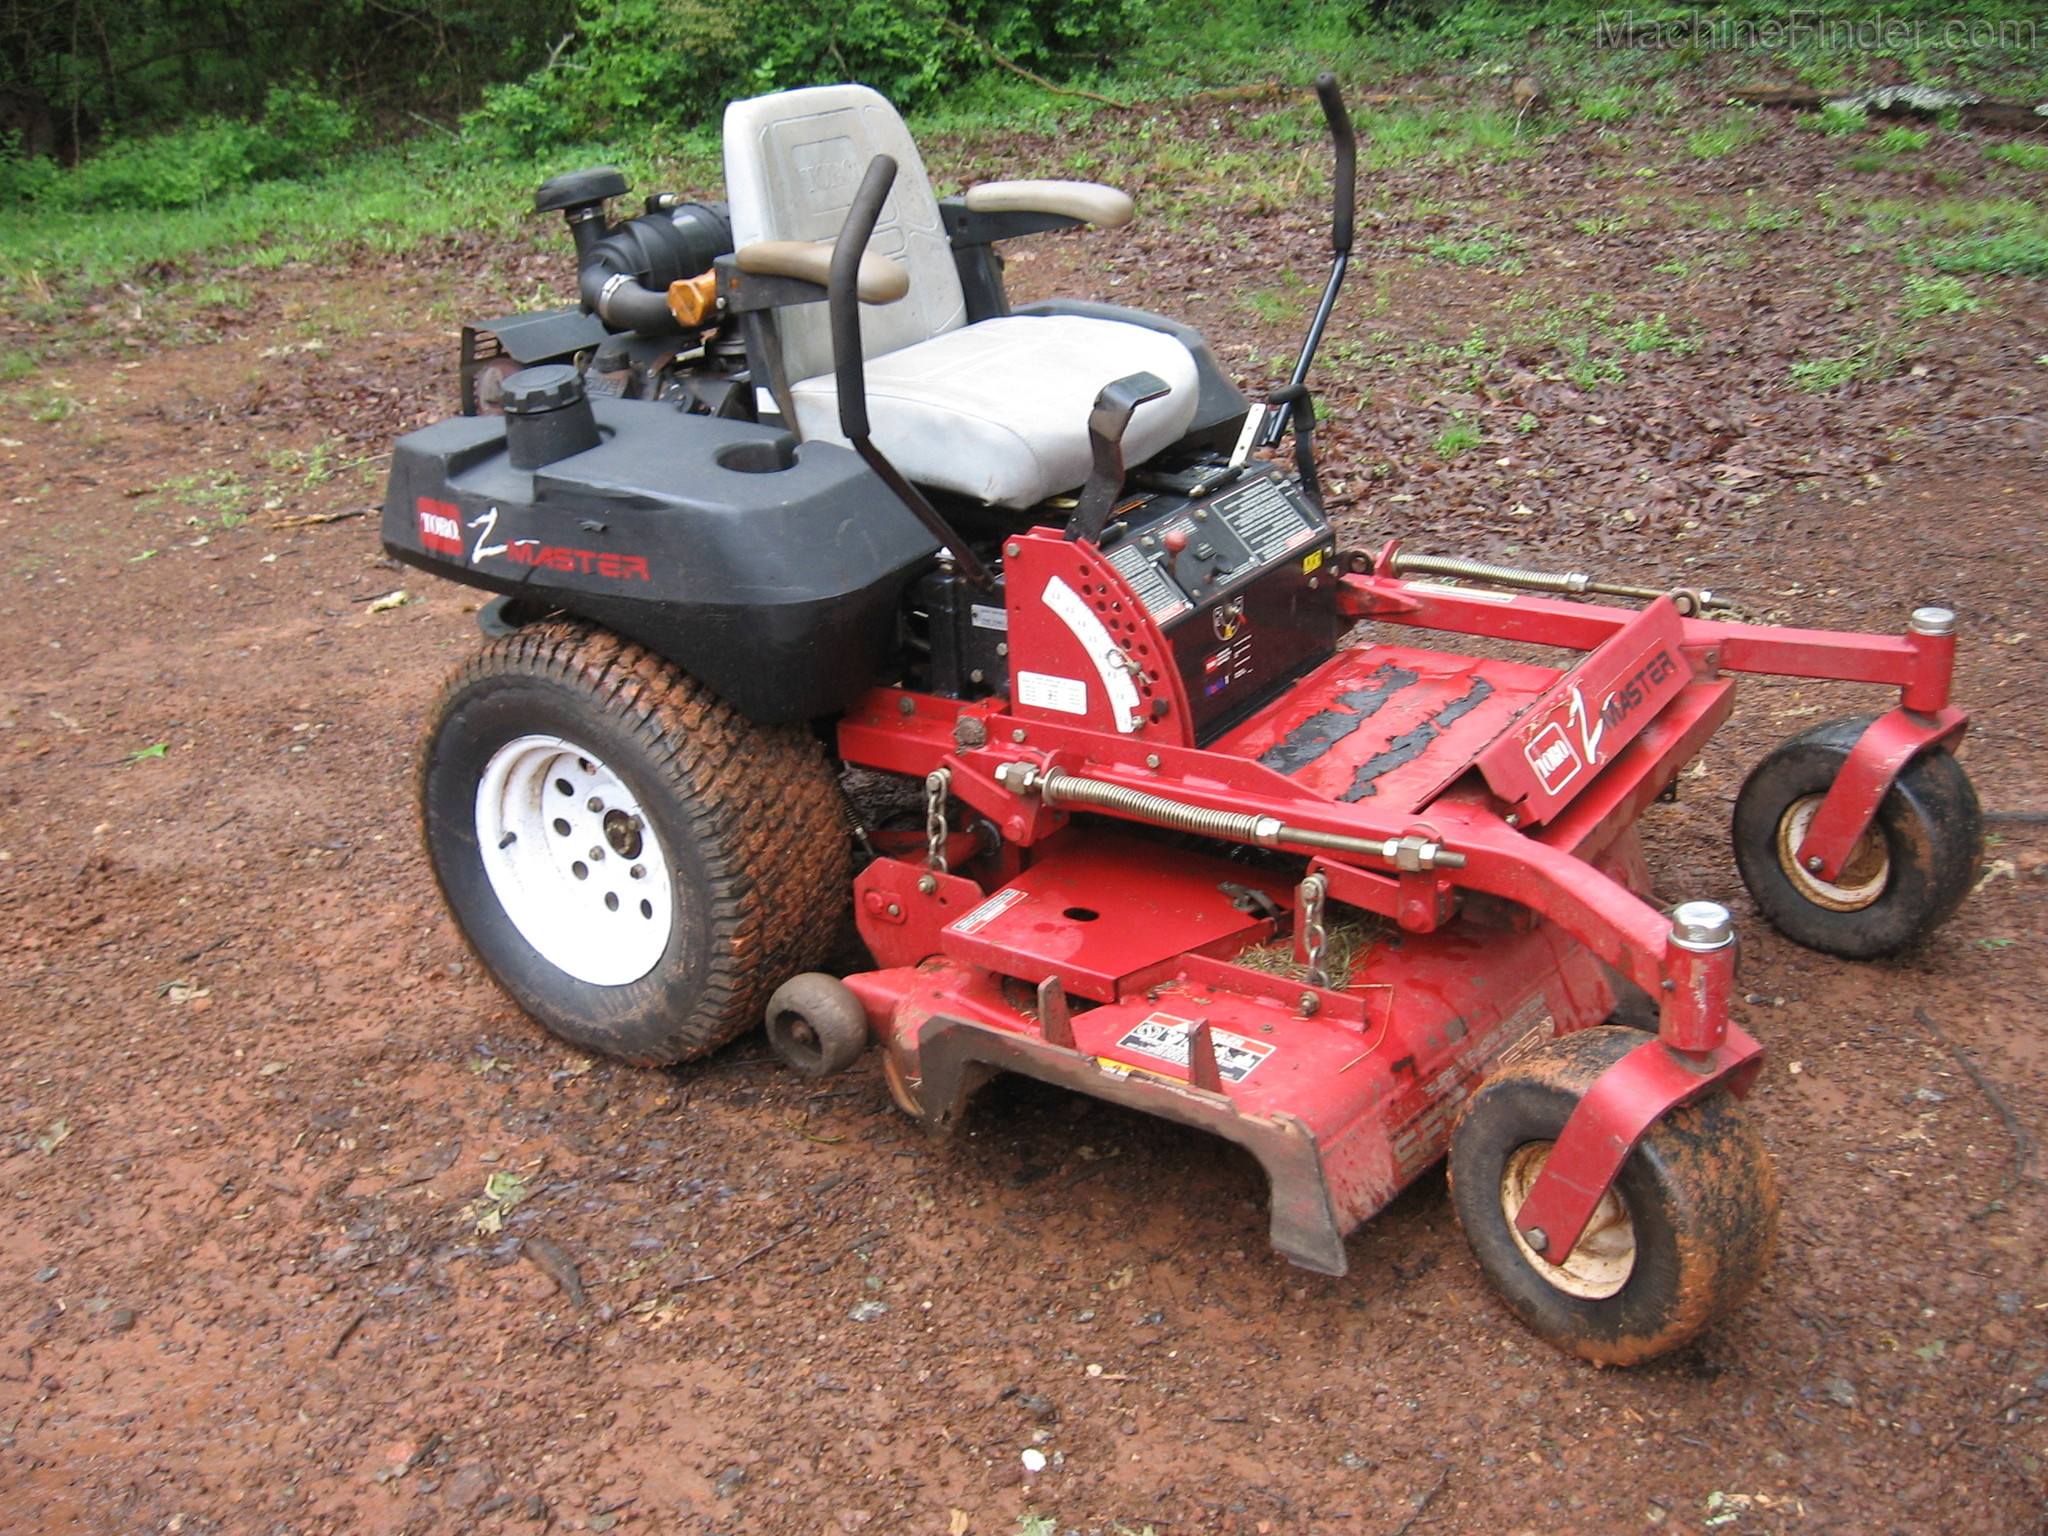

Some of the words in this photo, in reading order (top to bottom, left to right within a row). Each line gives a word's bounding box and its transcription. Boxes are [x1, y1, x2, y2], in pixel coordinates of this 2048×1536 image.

[420, 512, 461, 541] TORO
[467, 506, 526, 564] Z
[507, 540, 650, 581] MASTER
[1534, 740, 1571, 778] TORO
[1600, 650, 1676, 732] MASTER
